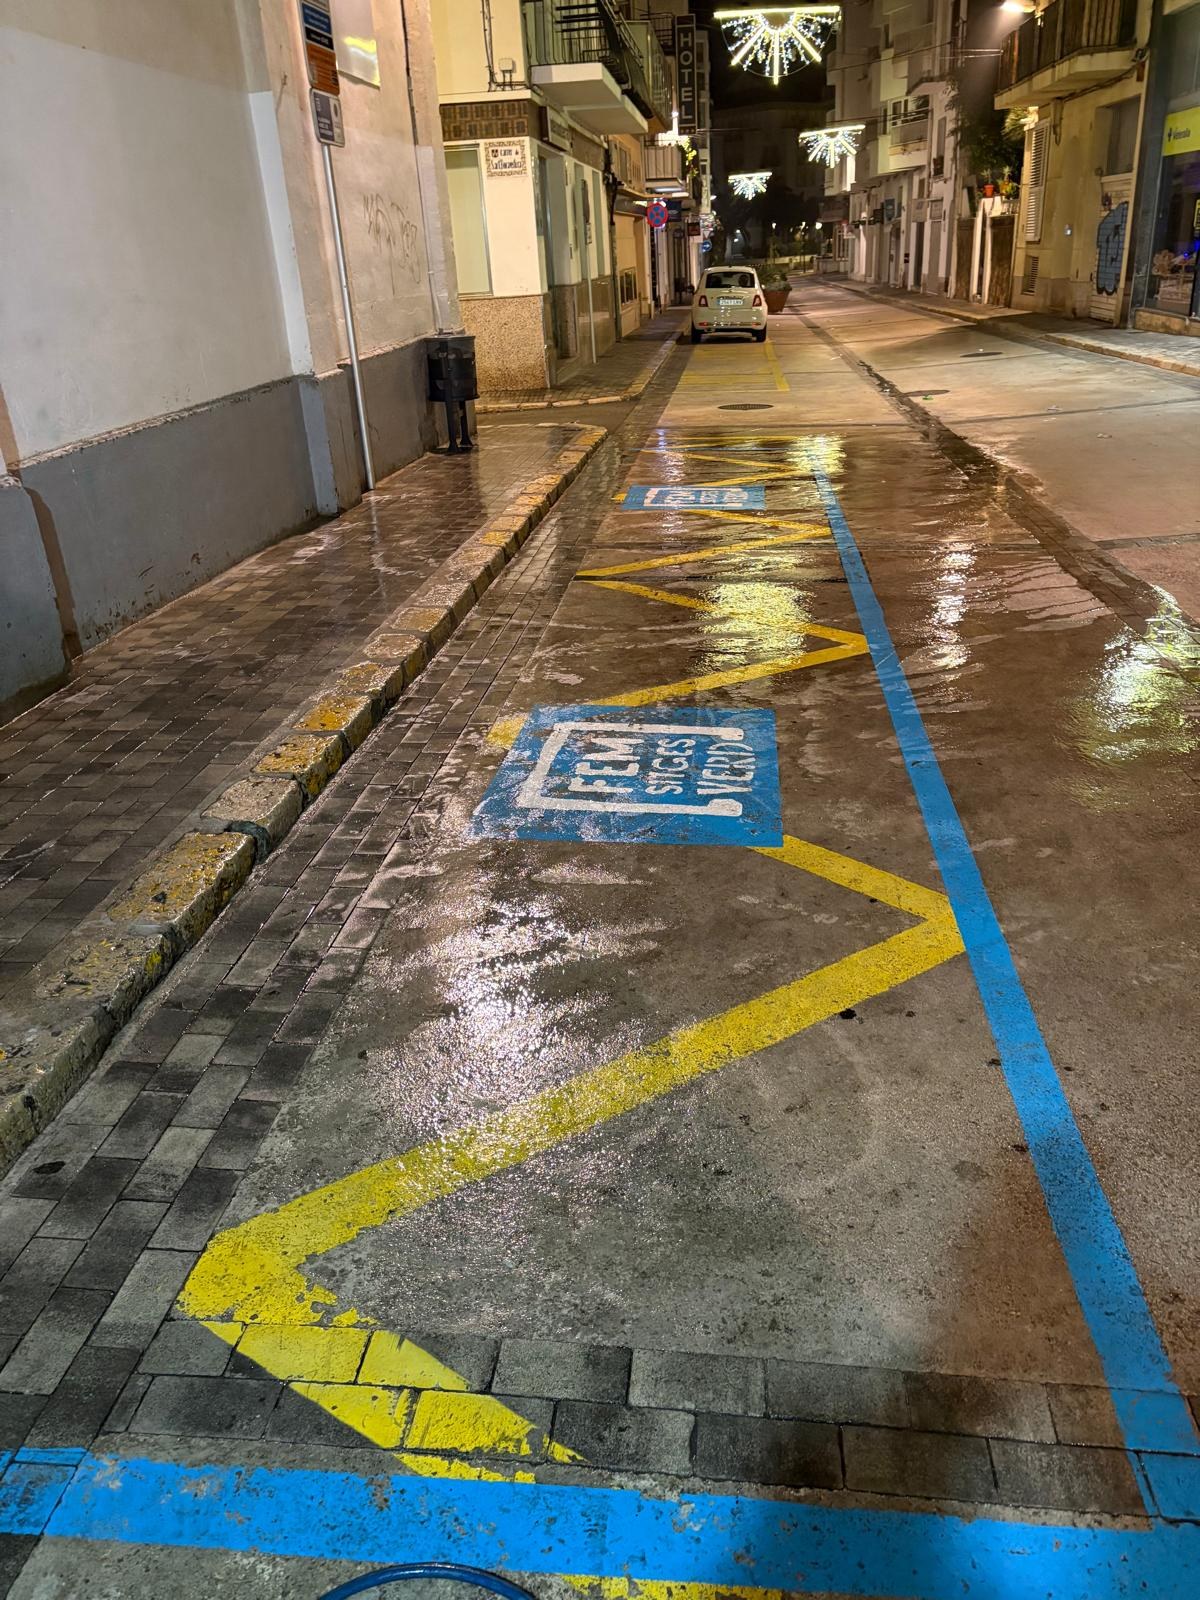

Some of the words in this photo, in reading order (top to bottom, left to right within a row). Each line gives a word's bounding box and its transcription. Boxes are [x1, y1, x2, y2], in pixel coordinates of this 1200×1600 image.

[680, 32, 693, 119] HOTEL
[568, 737, 645, 795] FEM
[697, 743, 758, 796] VERD
